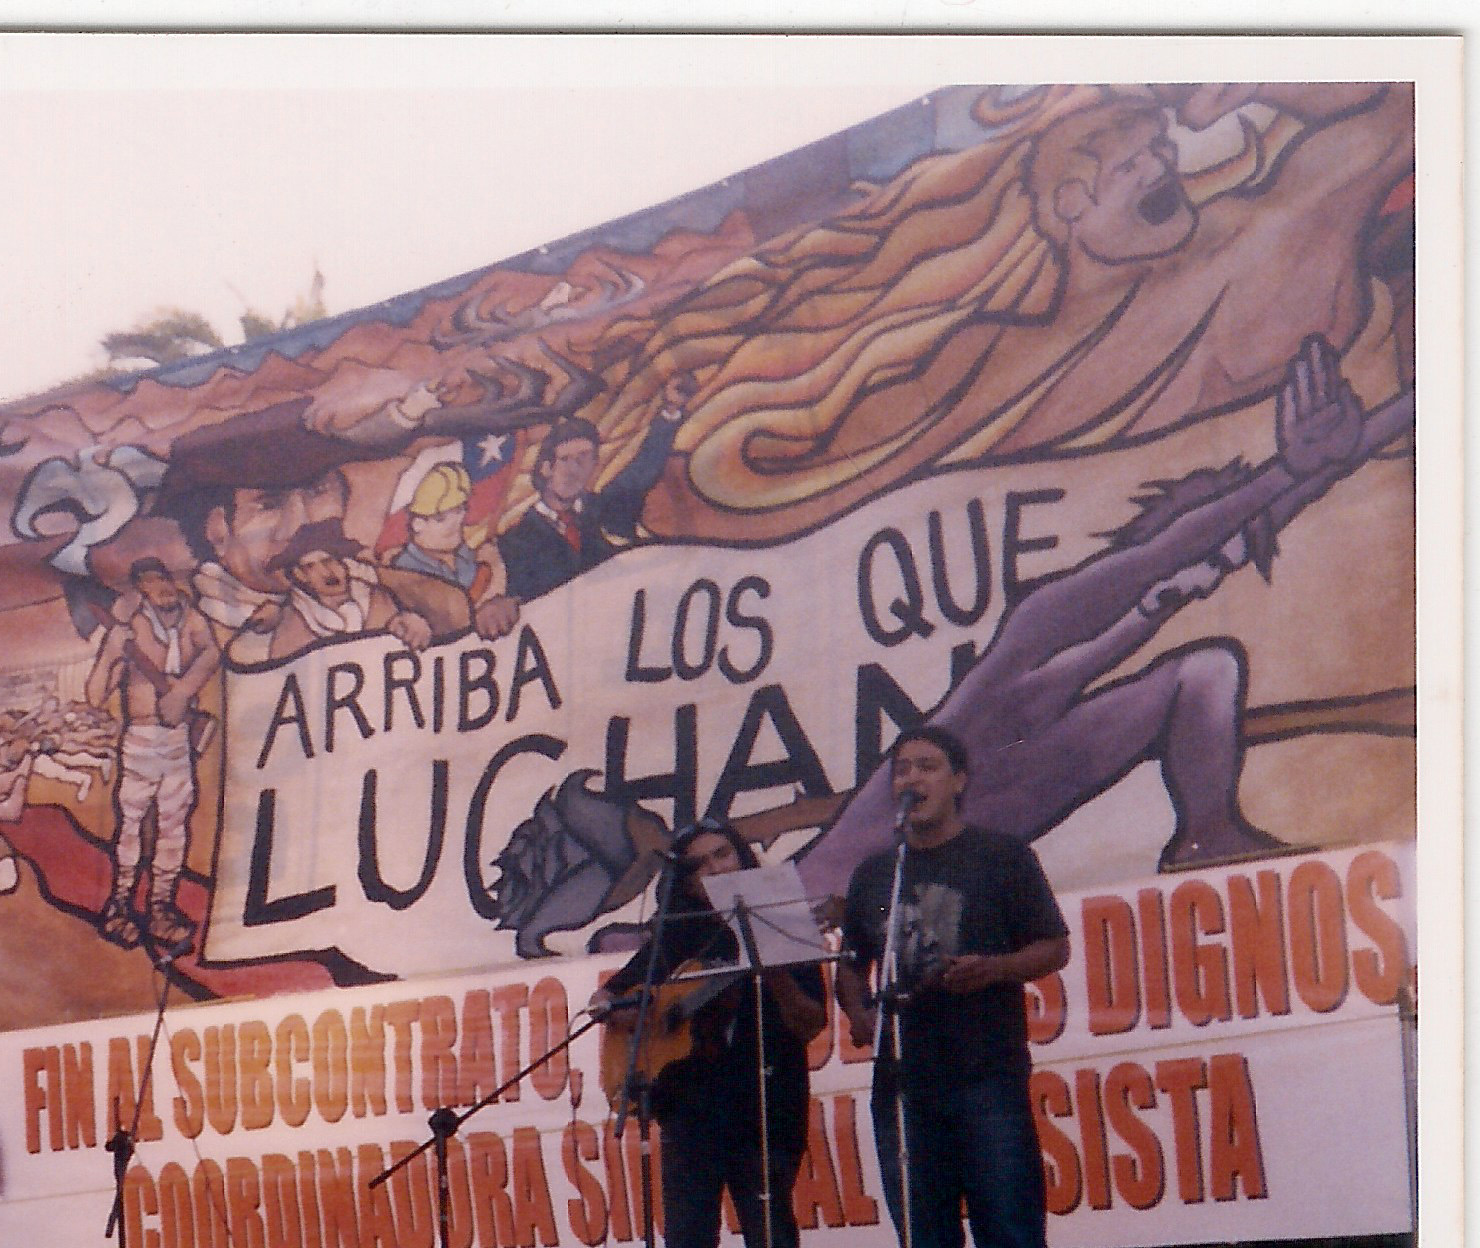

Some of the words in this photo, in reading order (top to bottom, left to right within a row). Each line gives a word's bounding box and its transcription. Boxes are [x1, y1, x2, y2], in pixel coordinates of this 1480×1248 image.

[256, 624, 562, 768] ARRIBA
[623, 574, 772, 684] LOS
[857, 488, 1066, 647] QUE
[23, 1040, 97, 1154] FIN
[107, 1036, 163, 1143] AL
[170, 977, 584, 1140] SUBCONTRATO,
[1081, 850, 1409, 1036] DIGNOS
